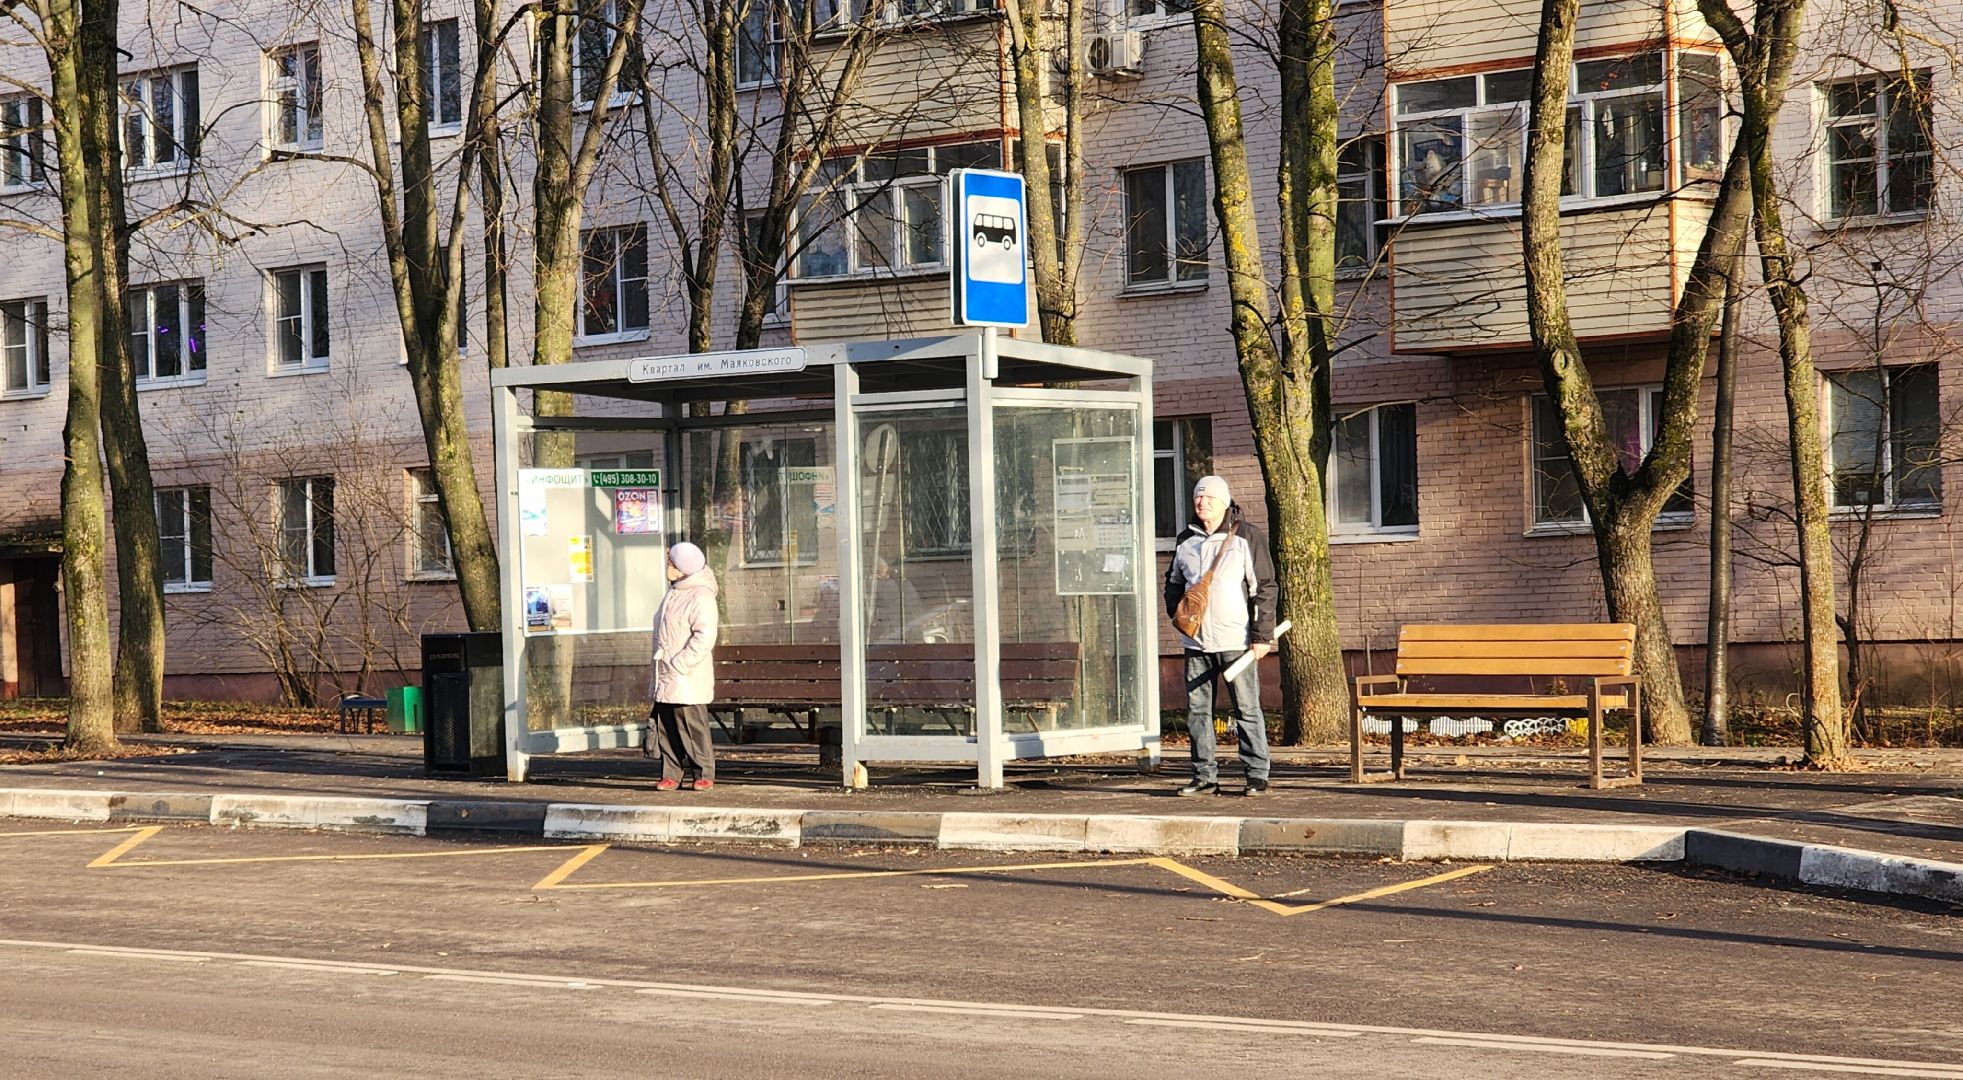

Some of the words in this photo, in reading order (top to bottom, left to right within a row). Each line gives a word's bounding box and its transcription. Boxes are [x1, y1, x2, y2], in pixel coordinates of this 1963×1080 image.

[642, 363, 685, 375] Квартал
[697, 363, 713, 371] им.
[720, 355, 792, 370] Маяковского
[599, 472, 620, 486] (495)
[620, 473, 657, 484] 308-30-10
[617, 491, 647, 501] OZON
